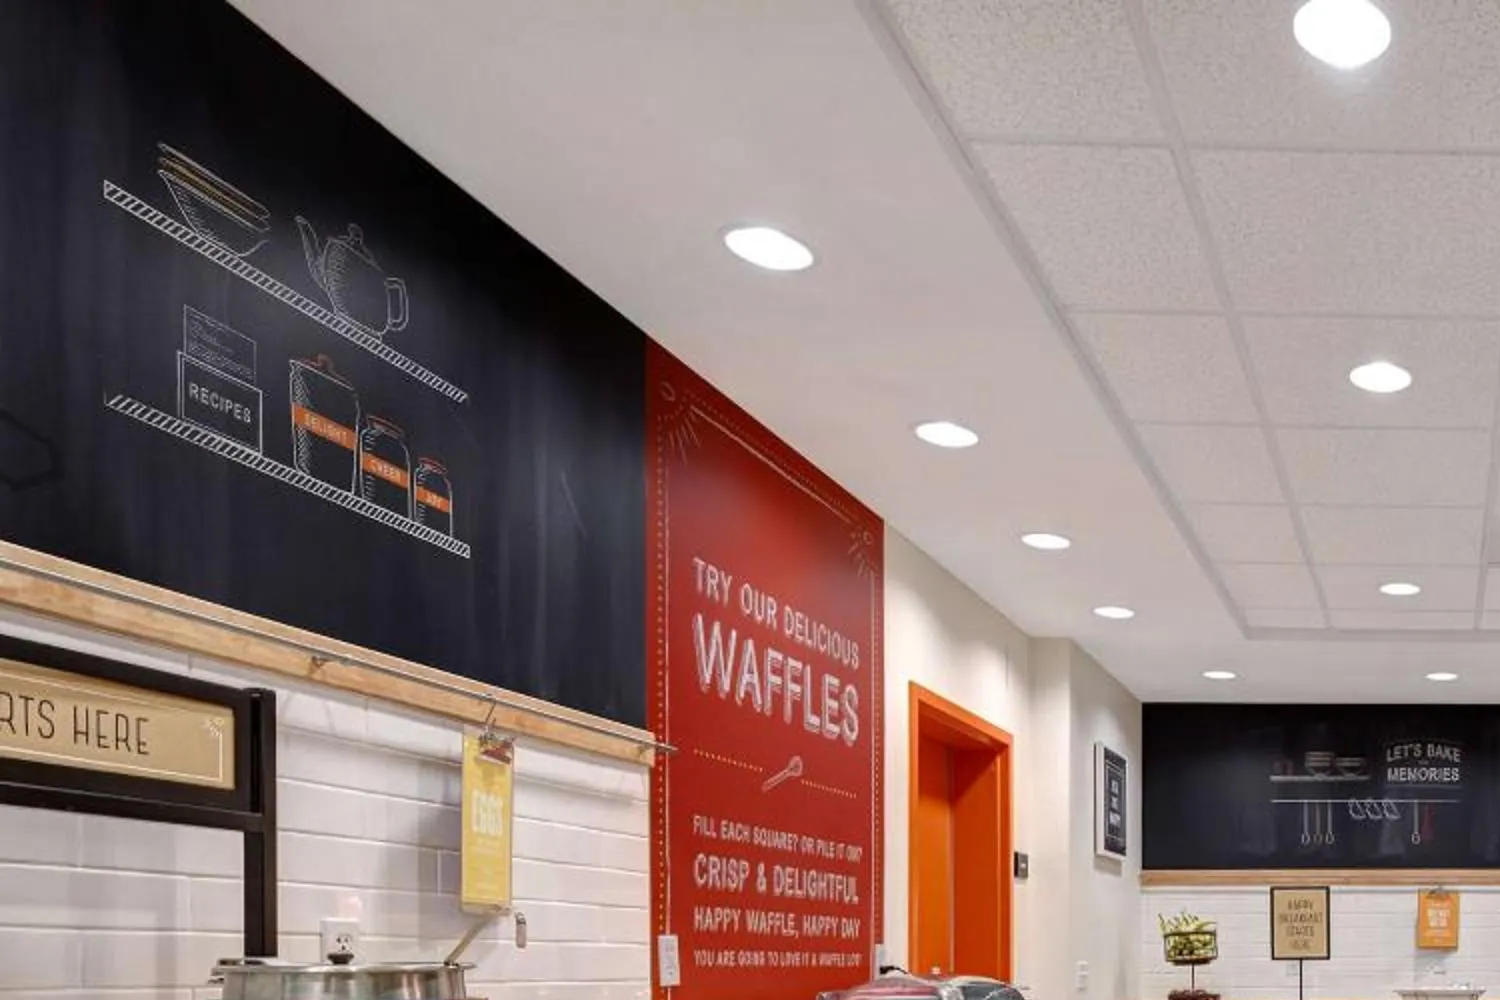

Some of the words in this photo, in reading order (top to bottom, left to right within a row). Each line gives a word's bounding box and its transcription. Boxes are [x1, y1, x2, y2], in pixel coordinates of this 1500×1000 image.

[188, 382, 252, 424] RECIPES
[692, 556, 732, 603] TRY
[740, 583, 778, 630] OUR
[783, 605, 860, 671] DELICIOUS
[692, 612, 859, 746] WAFFLES
[73, 705, 150, 755] HERE
[1386, 743, 1421, 763] LET'S
[1387, 766, 1459, 782] MEMORIES
[693, 815, 717, 839] FILL
[720, 819, 750, 844] EACH
[801, 835, 815, 857] OR
[694, 853, 750, 893] CRISP
[756, 860, 767, 894] &
[772, 863, 860, 905] DELIGHTFUL
[693, 905, 742, 933] HAPPY
[803, 914, 839, 937] HAPPY
[841, 917, 861, 939] DAY
[693, 949, 715, 967] YOU
[715, 950, 735, 967] ARE
[738, 950, 765, 967] GOING
[767, 951, 779, 967] TO
